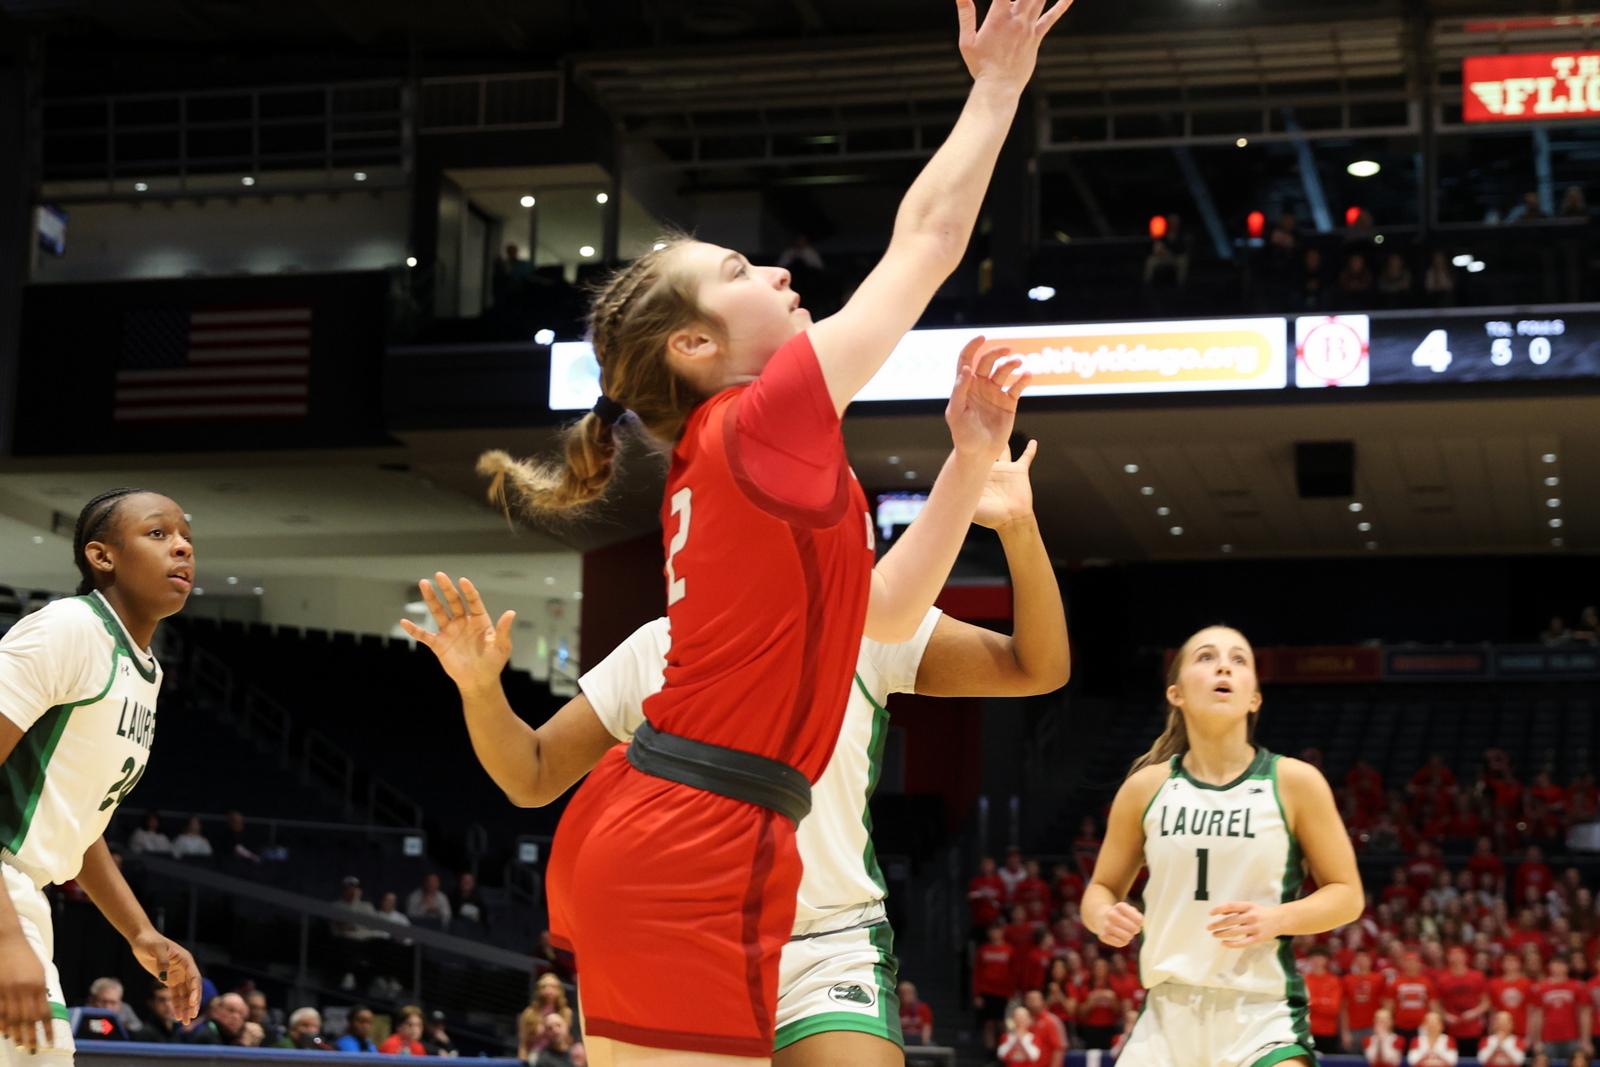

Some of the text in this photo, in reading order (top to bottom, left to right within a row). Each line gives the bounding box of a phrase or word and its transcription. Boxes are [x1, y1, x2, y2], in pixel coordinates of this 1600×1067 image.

[1412, 329, 1452, 372] 4
[1490, 337, 1551, 366] 5 0
[1160, 805, 1256, 838] LAUREL
[1194, 848, 1209, 901] 1
